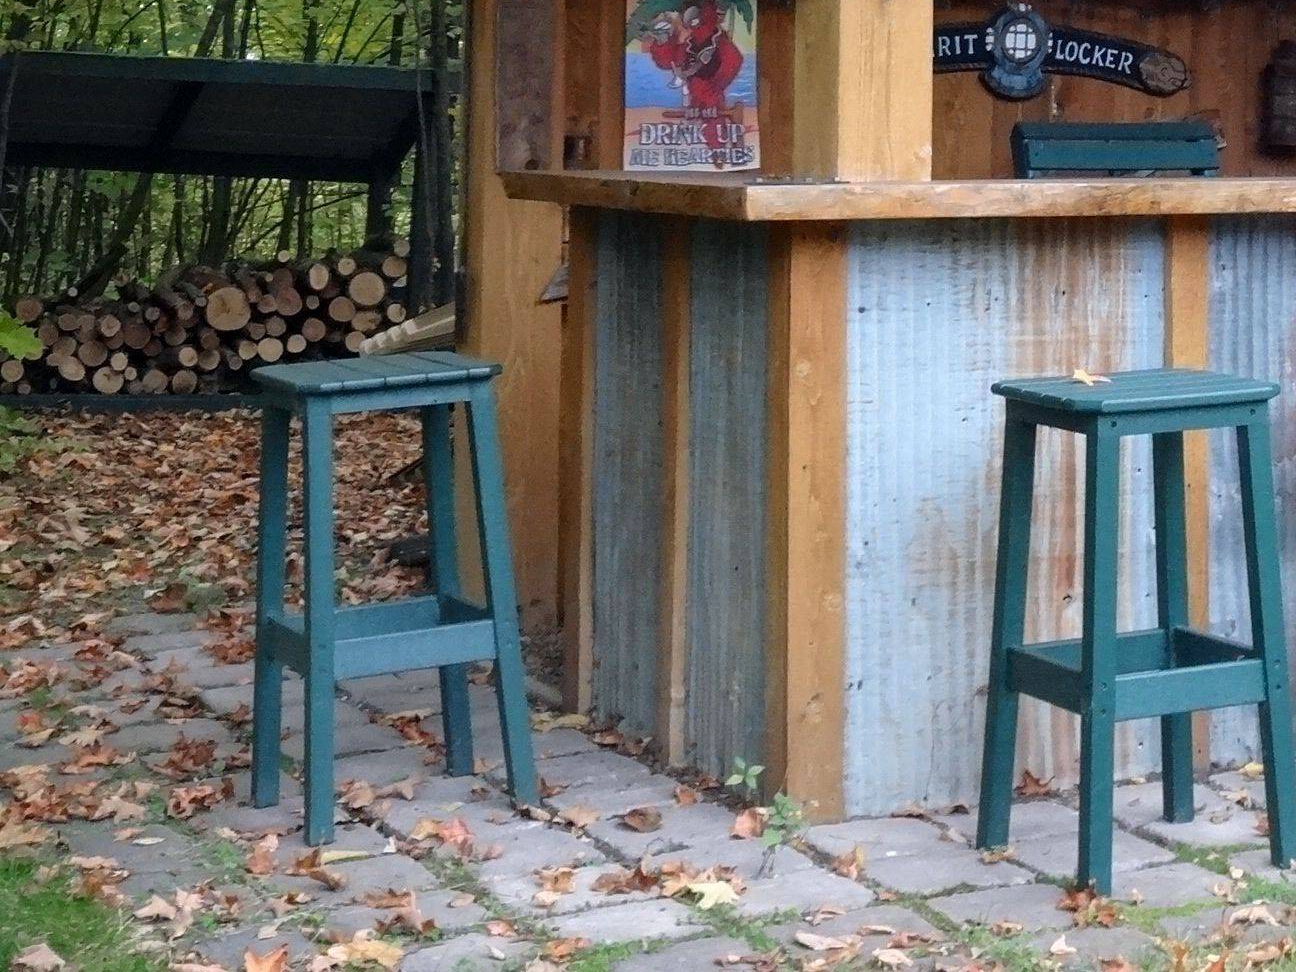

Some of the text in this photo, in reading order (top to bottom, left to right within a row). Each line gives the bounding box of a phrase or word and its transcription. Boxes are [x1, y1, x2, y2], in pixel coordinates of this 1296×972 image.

[935, 33, 1134, 75] RIT LOCKER
[640, 122, 747, 145] DRINK UP
